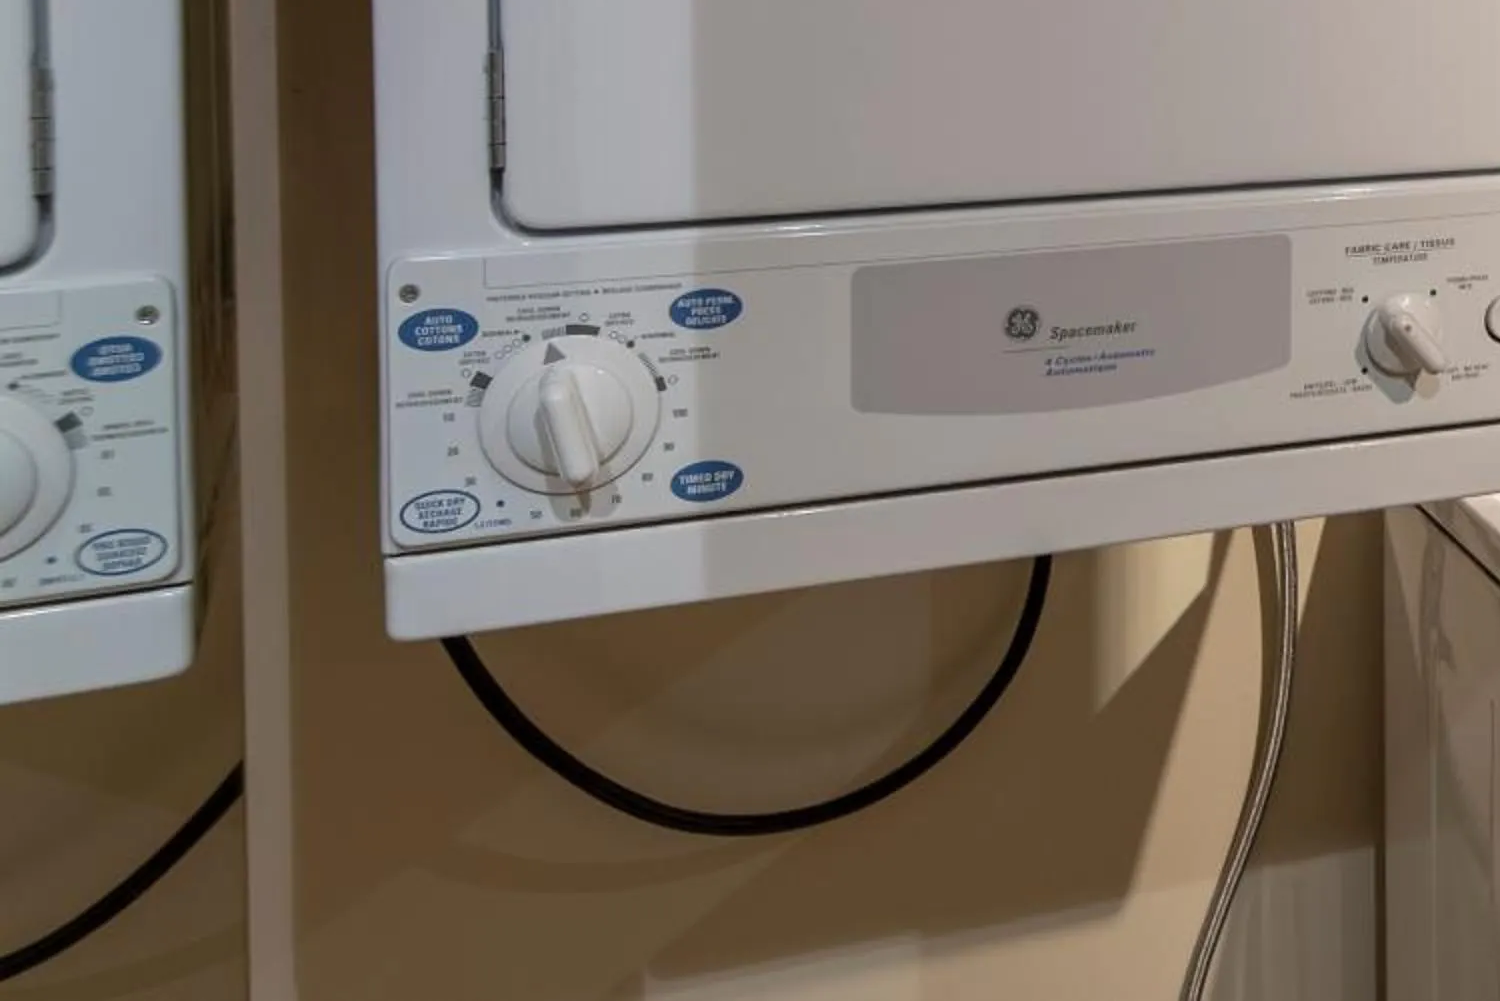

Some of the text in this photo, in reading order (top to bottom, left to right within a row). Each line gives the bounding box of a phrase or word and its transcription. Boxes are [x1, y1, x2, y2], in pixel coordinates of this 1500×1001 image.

[1384, 240, 1411, 252] CARE
[423, 314, 454, 326] AUTO
[414, 324, 465, 337] COTTONS
[1049, 318, 1138, 343] Spacemaker
